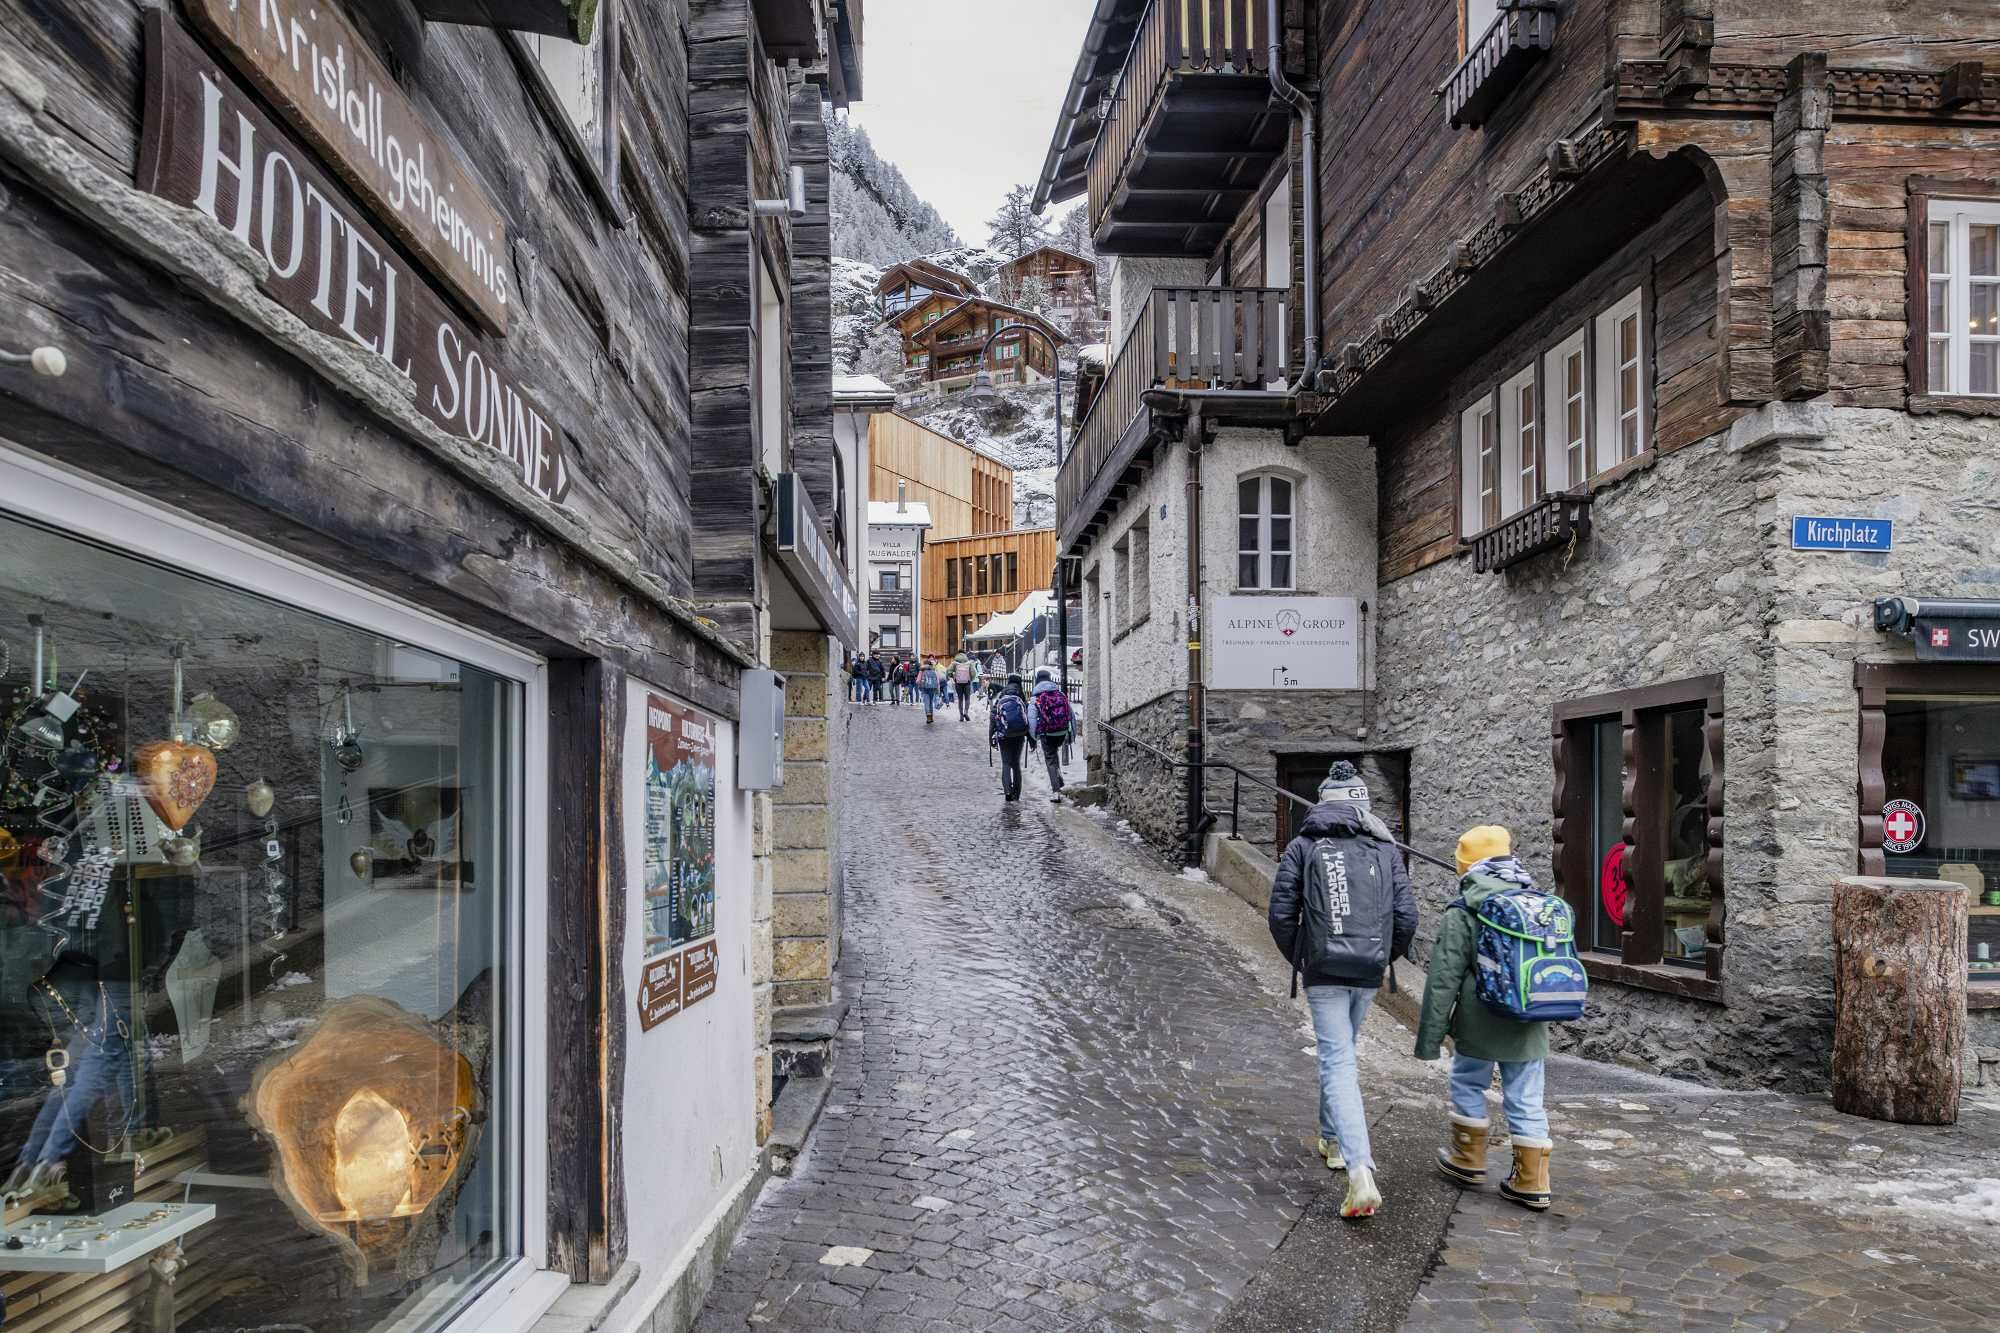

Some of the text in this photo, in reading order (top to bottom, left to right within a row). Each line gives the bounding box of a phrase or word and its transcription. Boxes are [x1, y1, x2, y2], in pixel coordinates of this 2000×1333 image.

[193, 71, 553, 500] HOTEL SONNE
[1807, 520, 1878, 549] Kirchplatz
[1227, 619, 1345, 629] ALPINE GROUP
[1882, 801, 1920, 816] SWISS MADE
[1884, 839, 1902, 851] SINCE
[1325, 860, 1344, 936] ARMOUR
[1335, 858, 1350, 917] UNDER
